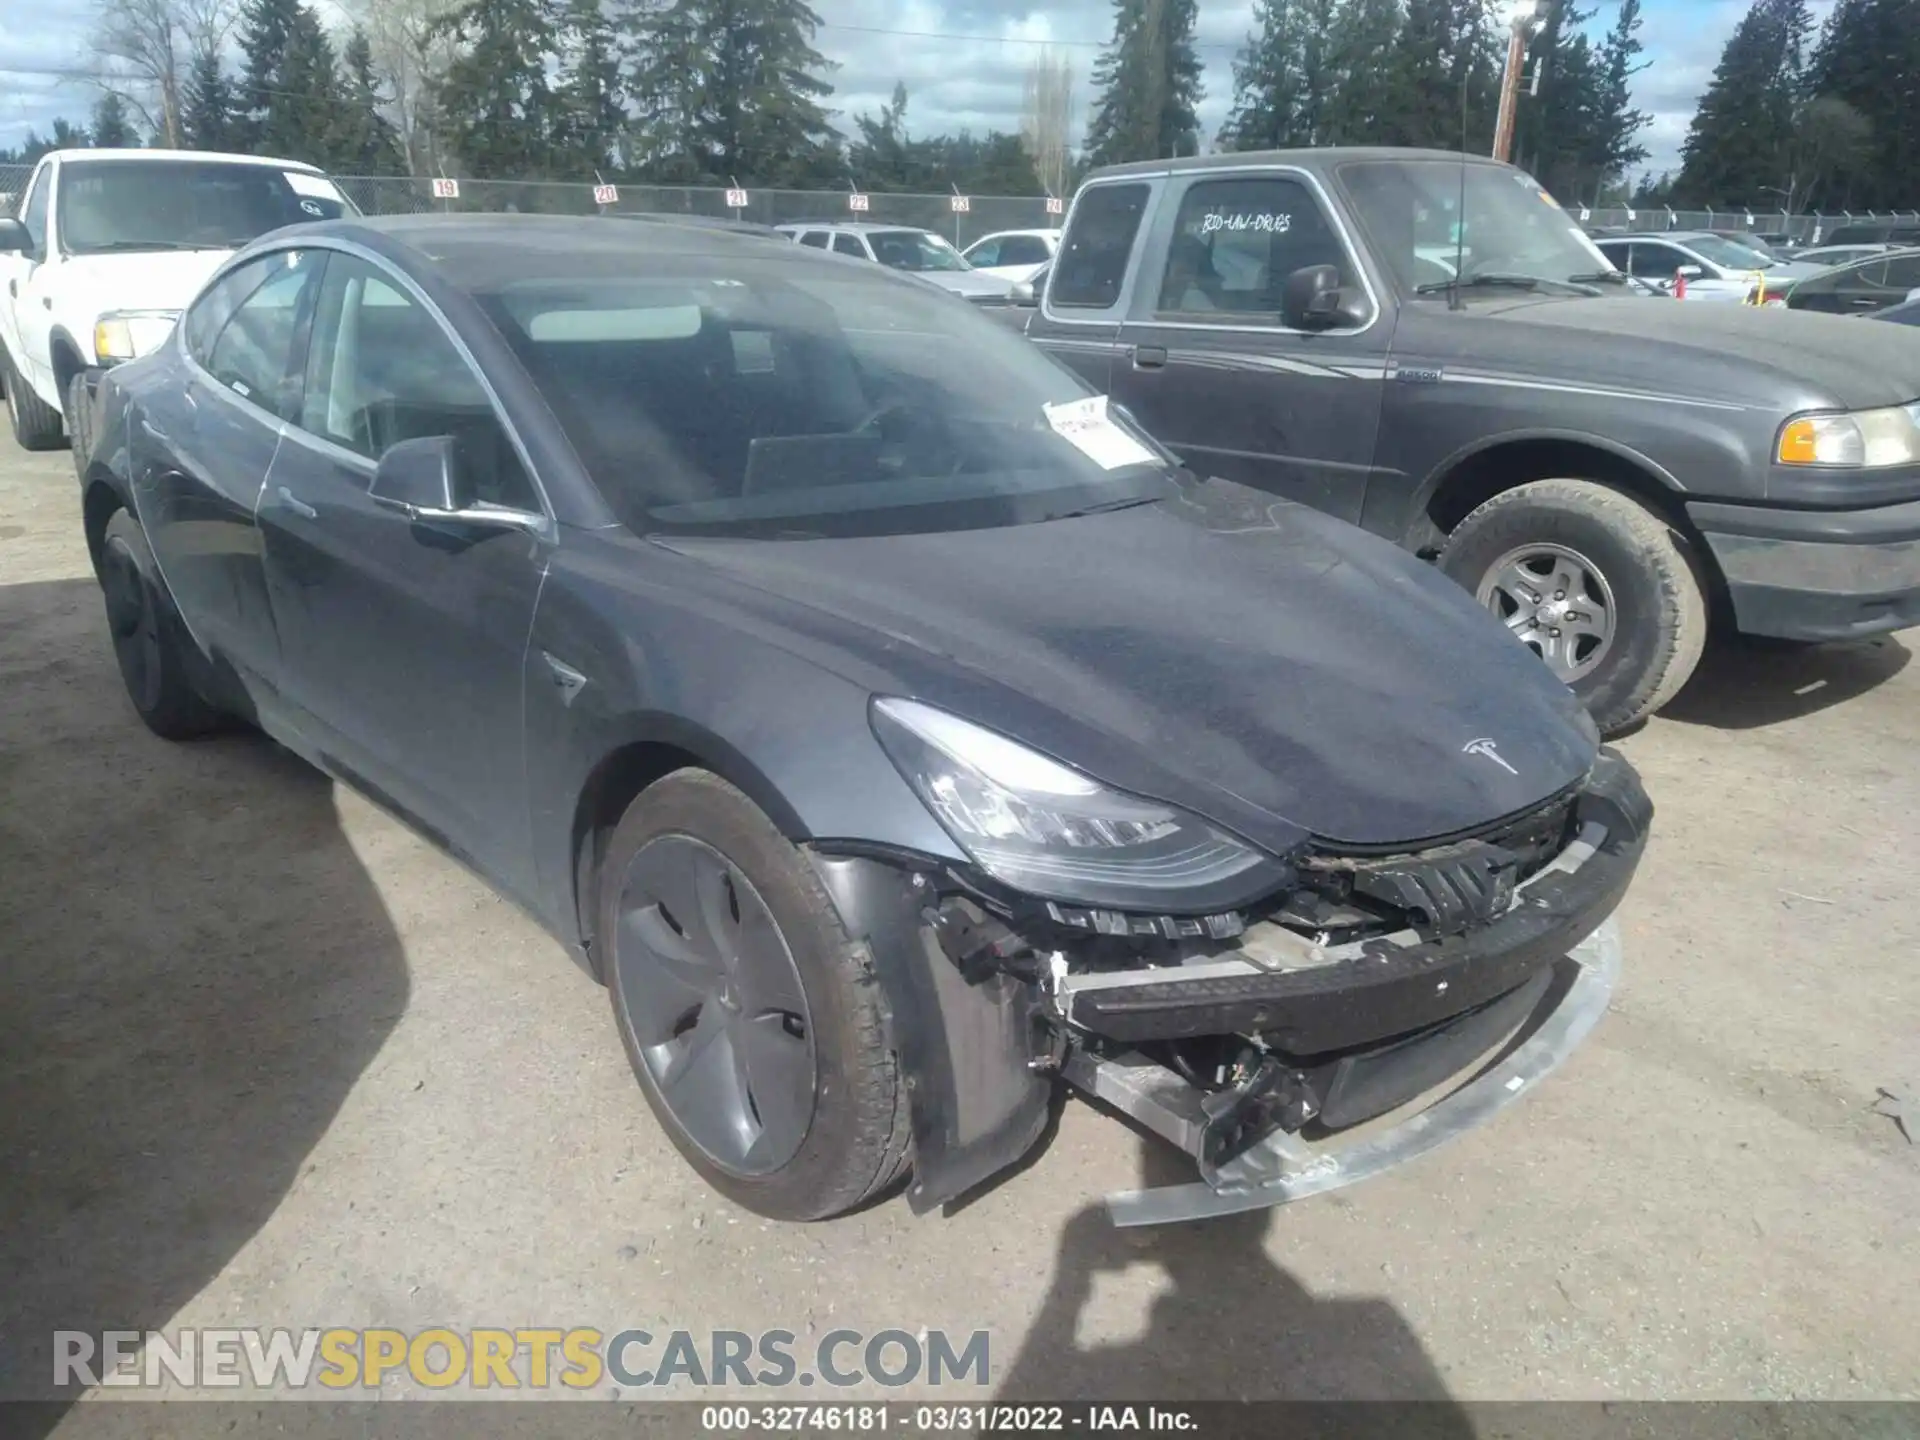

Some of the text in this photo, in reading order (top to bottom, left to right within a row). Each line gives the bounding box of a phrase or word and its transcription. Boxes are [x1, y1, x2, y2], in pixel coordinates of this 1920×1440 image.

[436, 180, 455, 196] 19
[596, 185, 615, 202] 20
[729, 190, 745, 205] 21
[851, 195, 866, 209] 22
